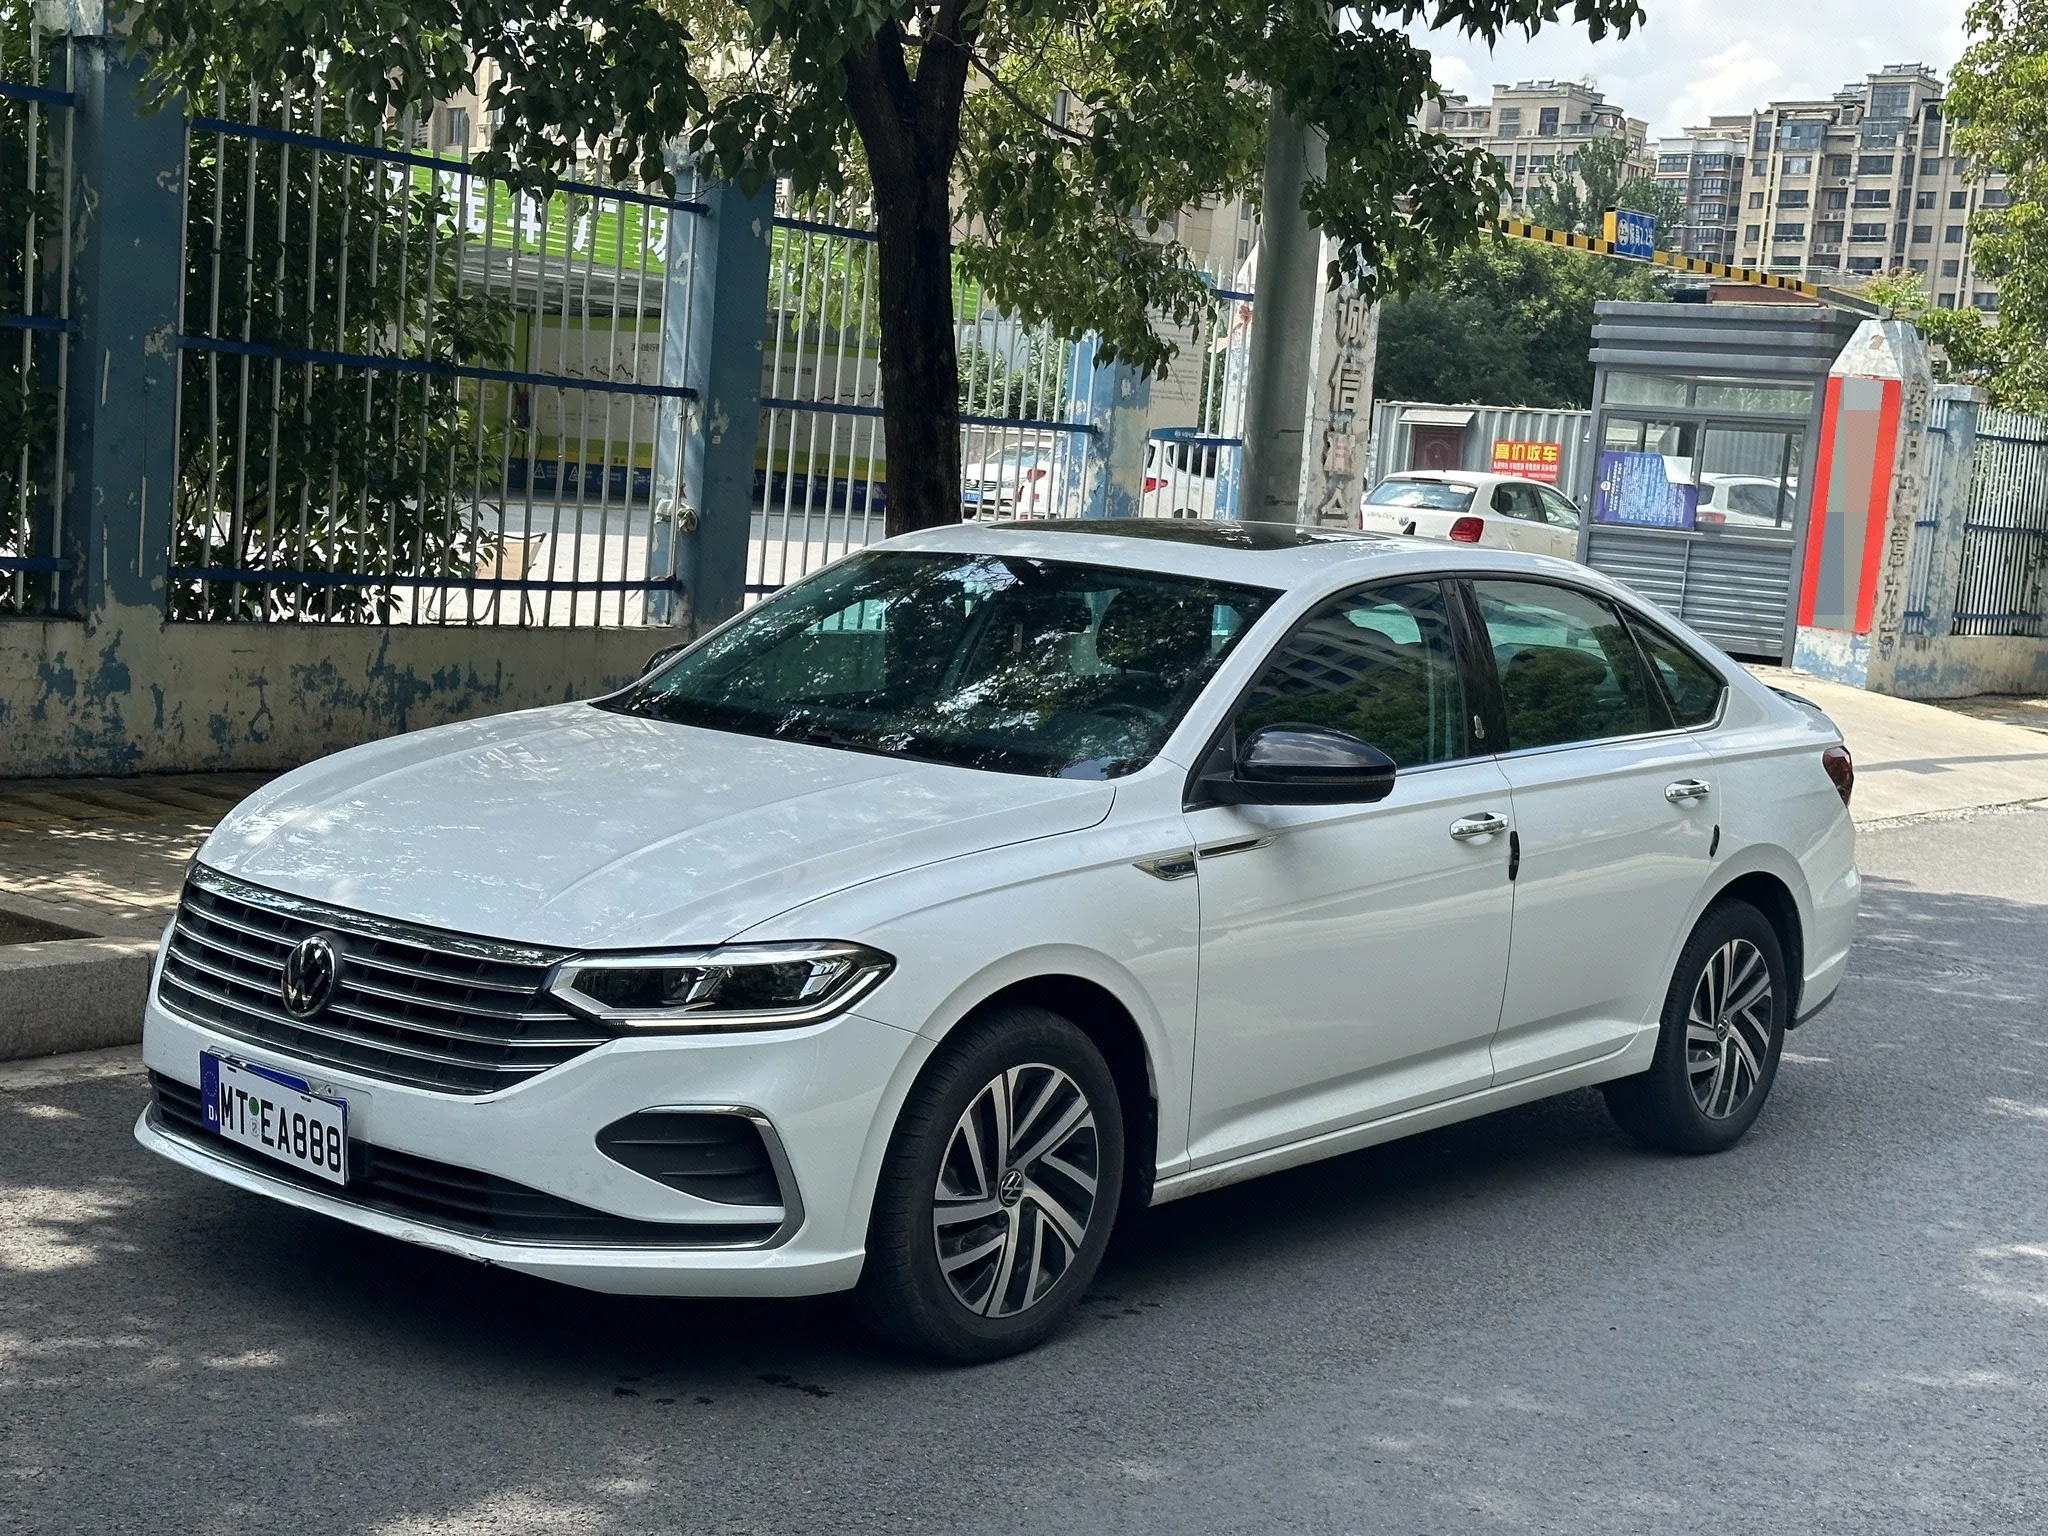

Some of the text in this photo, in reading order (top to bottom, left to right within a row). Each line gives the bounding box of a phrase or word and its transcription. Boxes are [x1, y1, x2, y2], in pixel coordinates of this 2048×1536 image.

[1495, 443, 1558, 463] 高价收车
[220, 1082, 342, 1174] MT EA888
